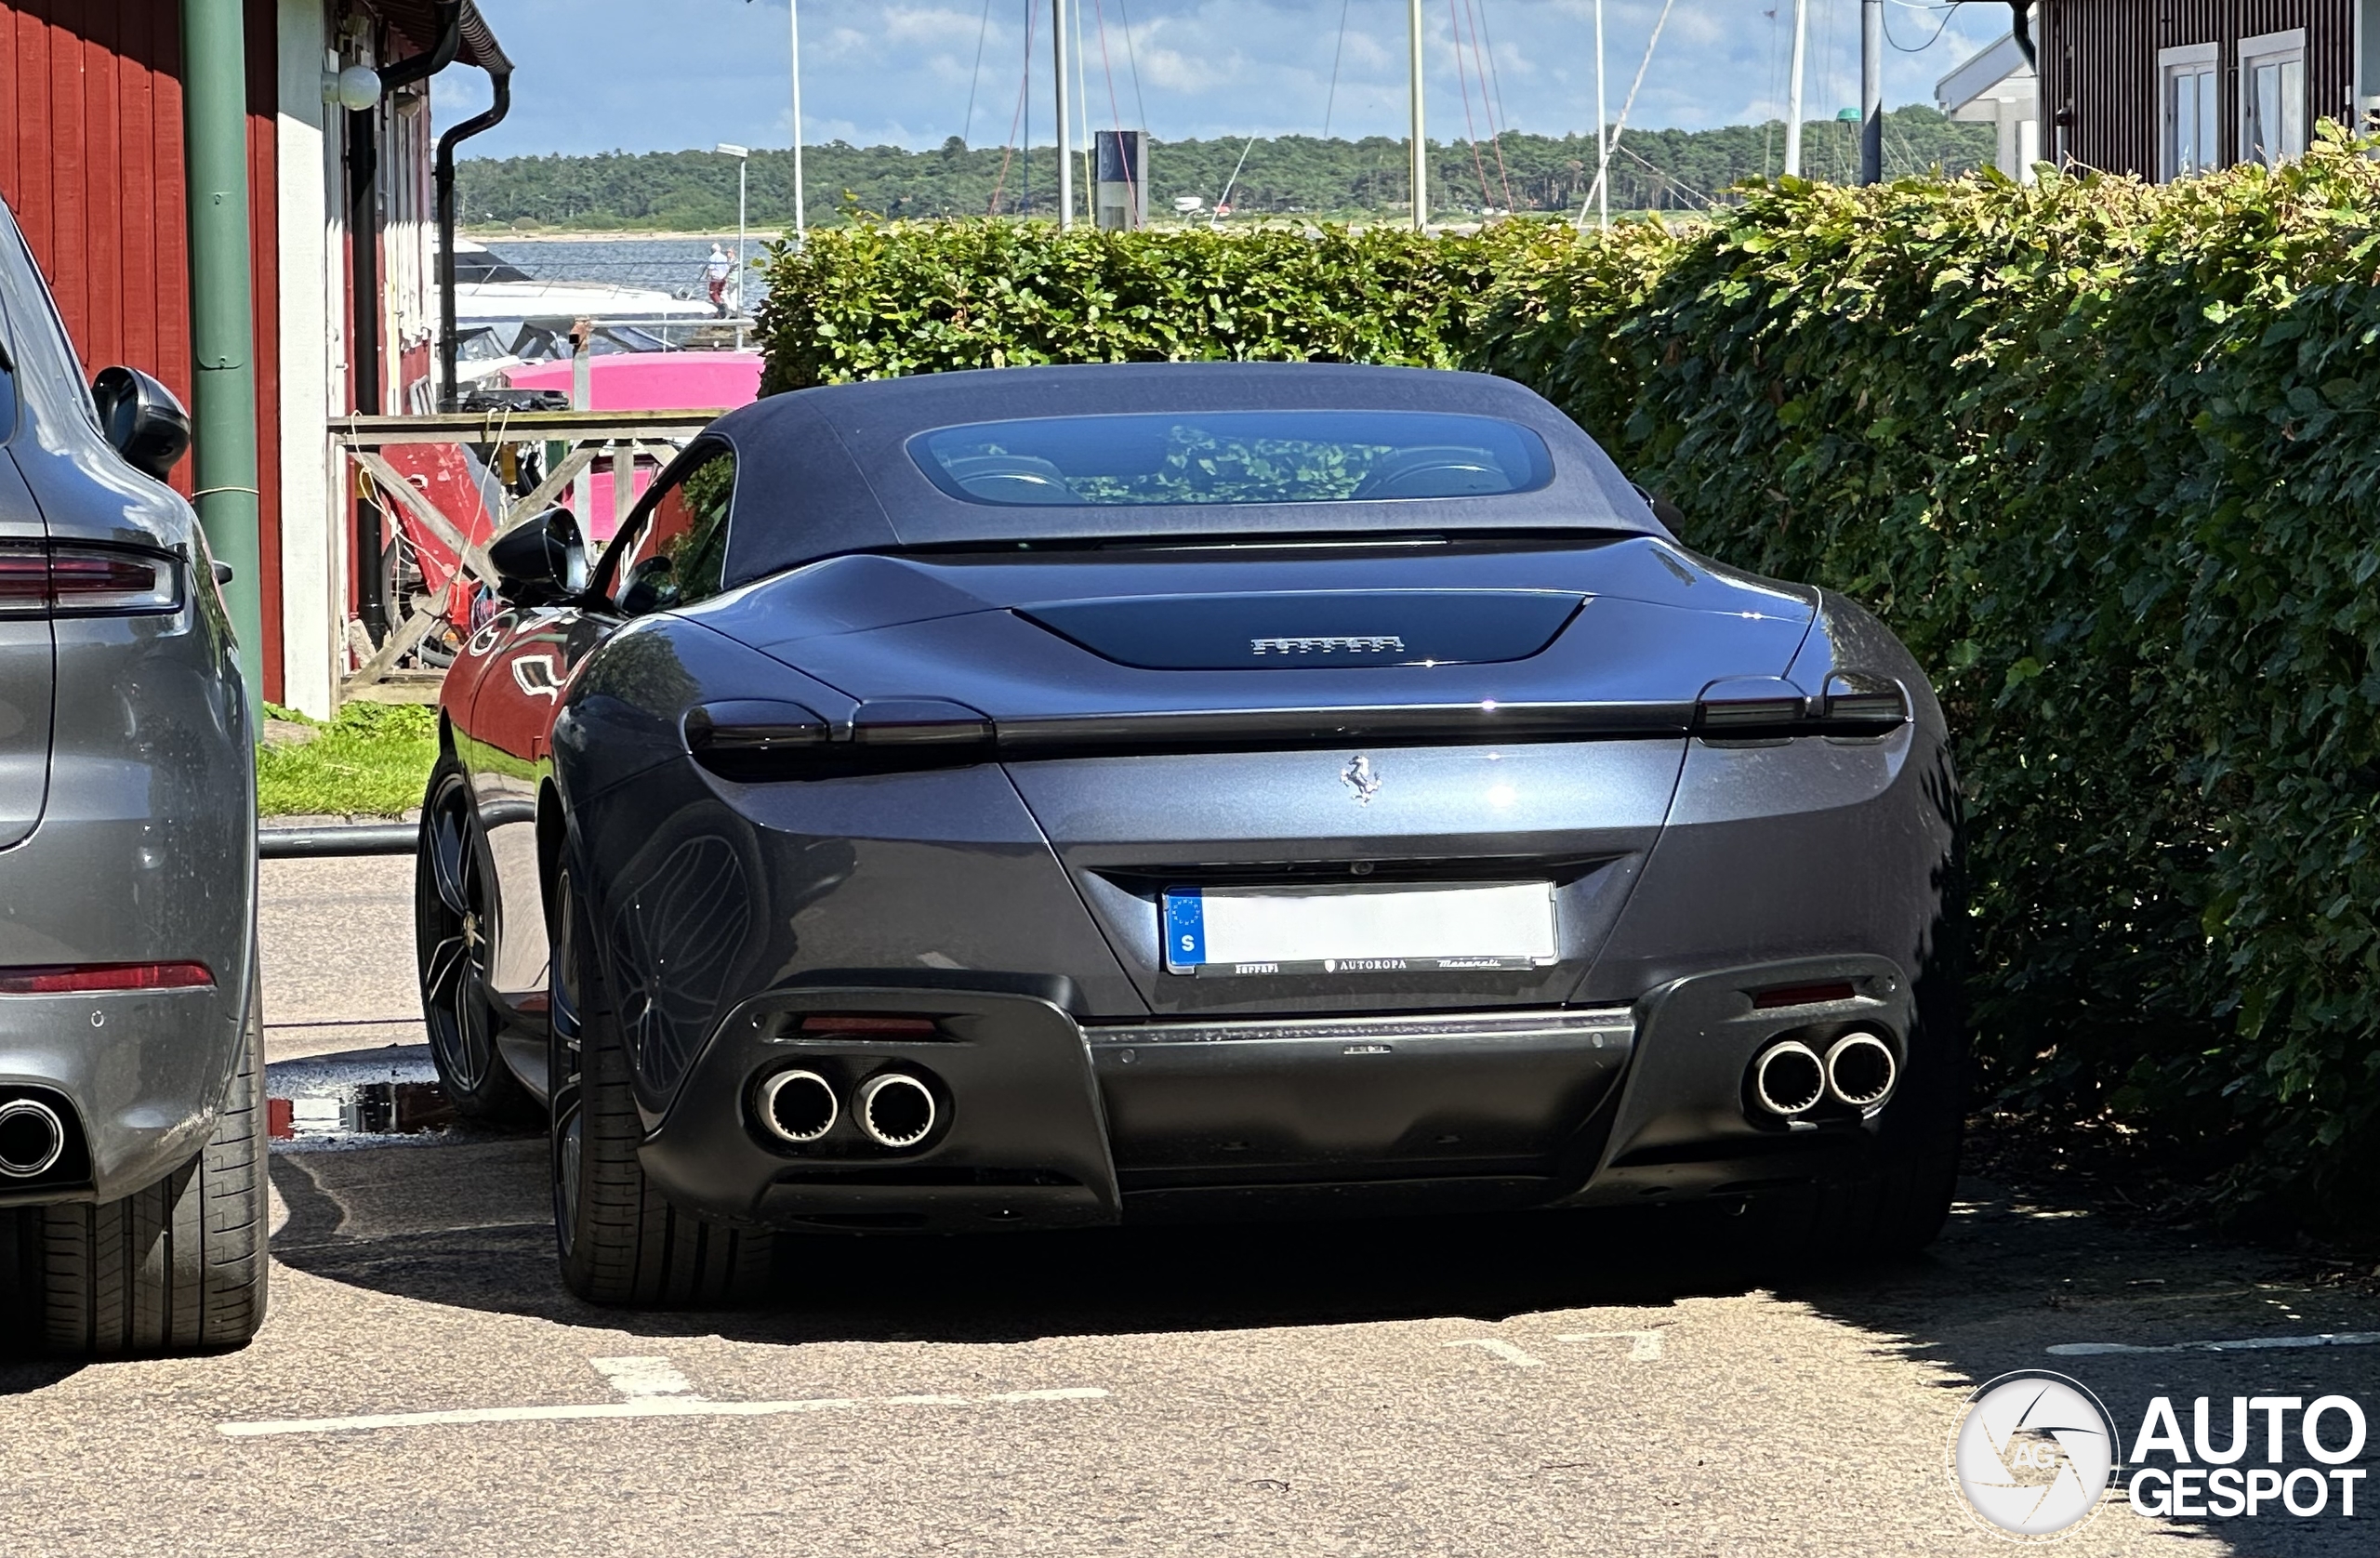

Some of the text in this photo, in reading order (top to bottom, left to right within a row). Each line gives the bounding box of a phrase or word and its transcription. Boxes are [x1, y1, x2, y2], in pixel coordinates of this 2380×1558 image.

[1250, 636, 1405, 655] Ferrari
[1181, 934, 1196, 952] S
[1340, 958, 1407, 970] AUTOROPA
